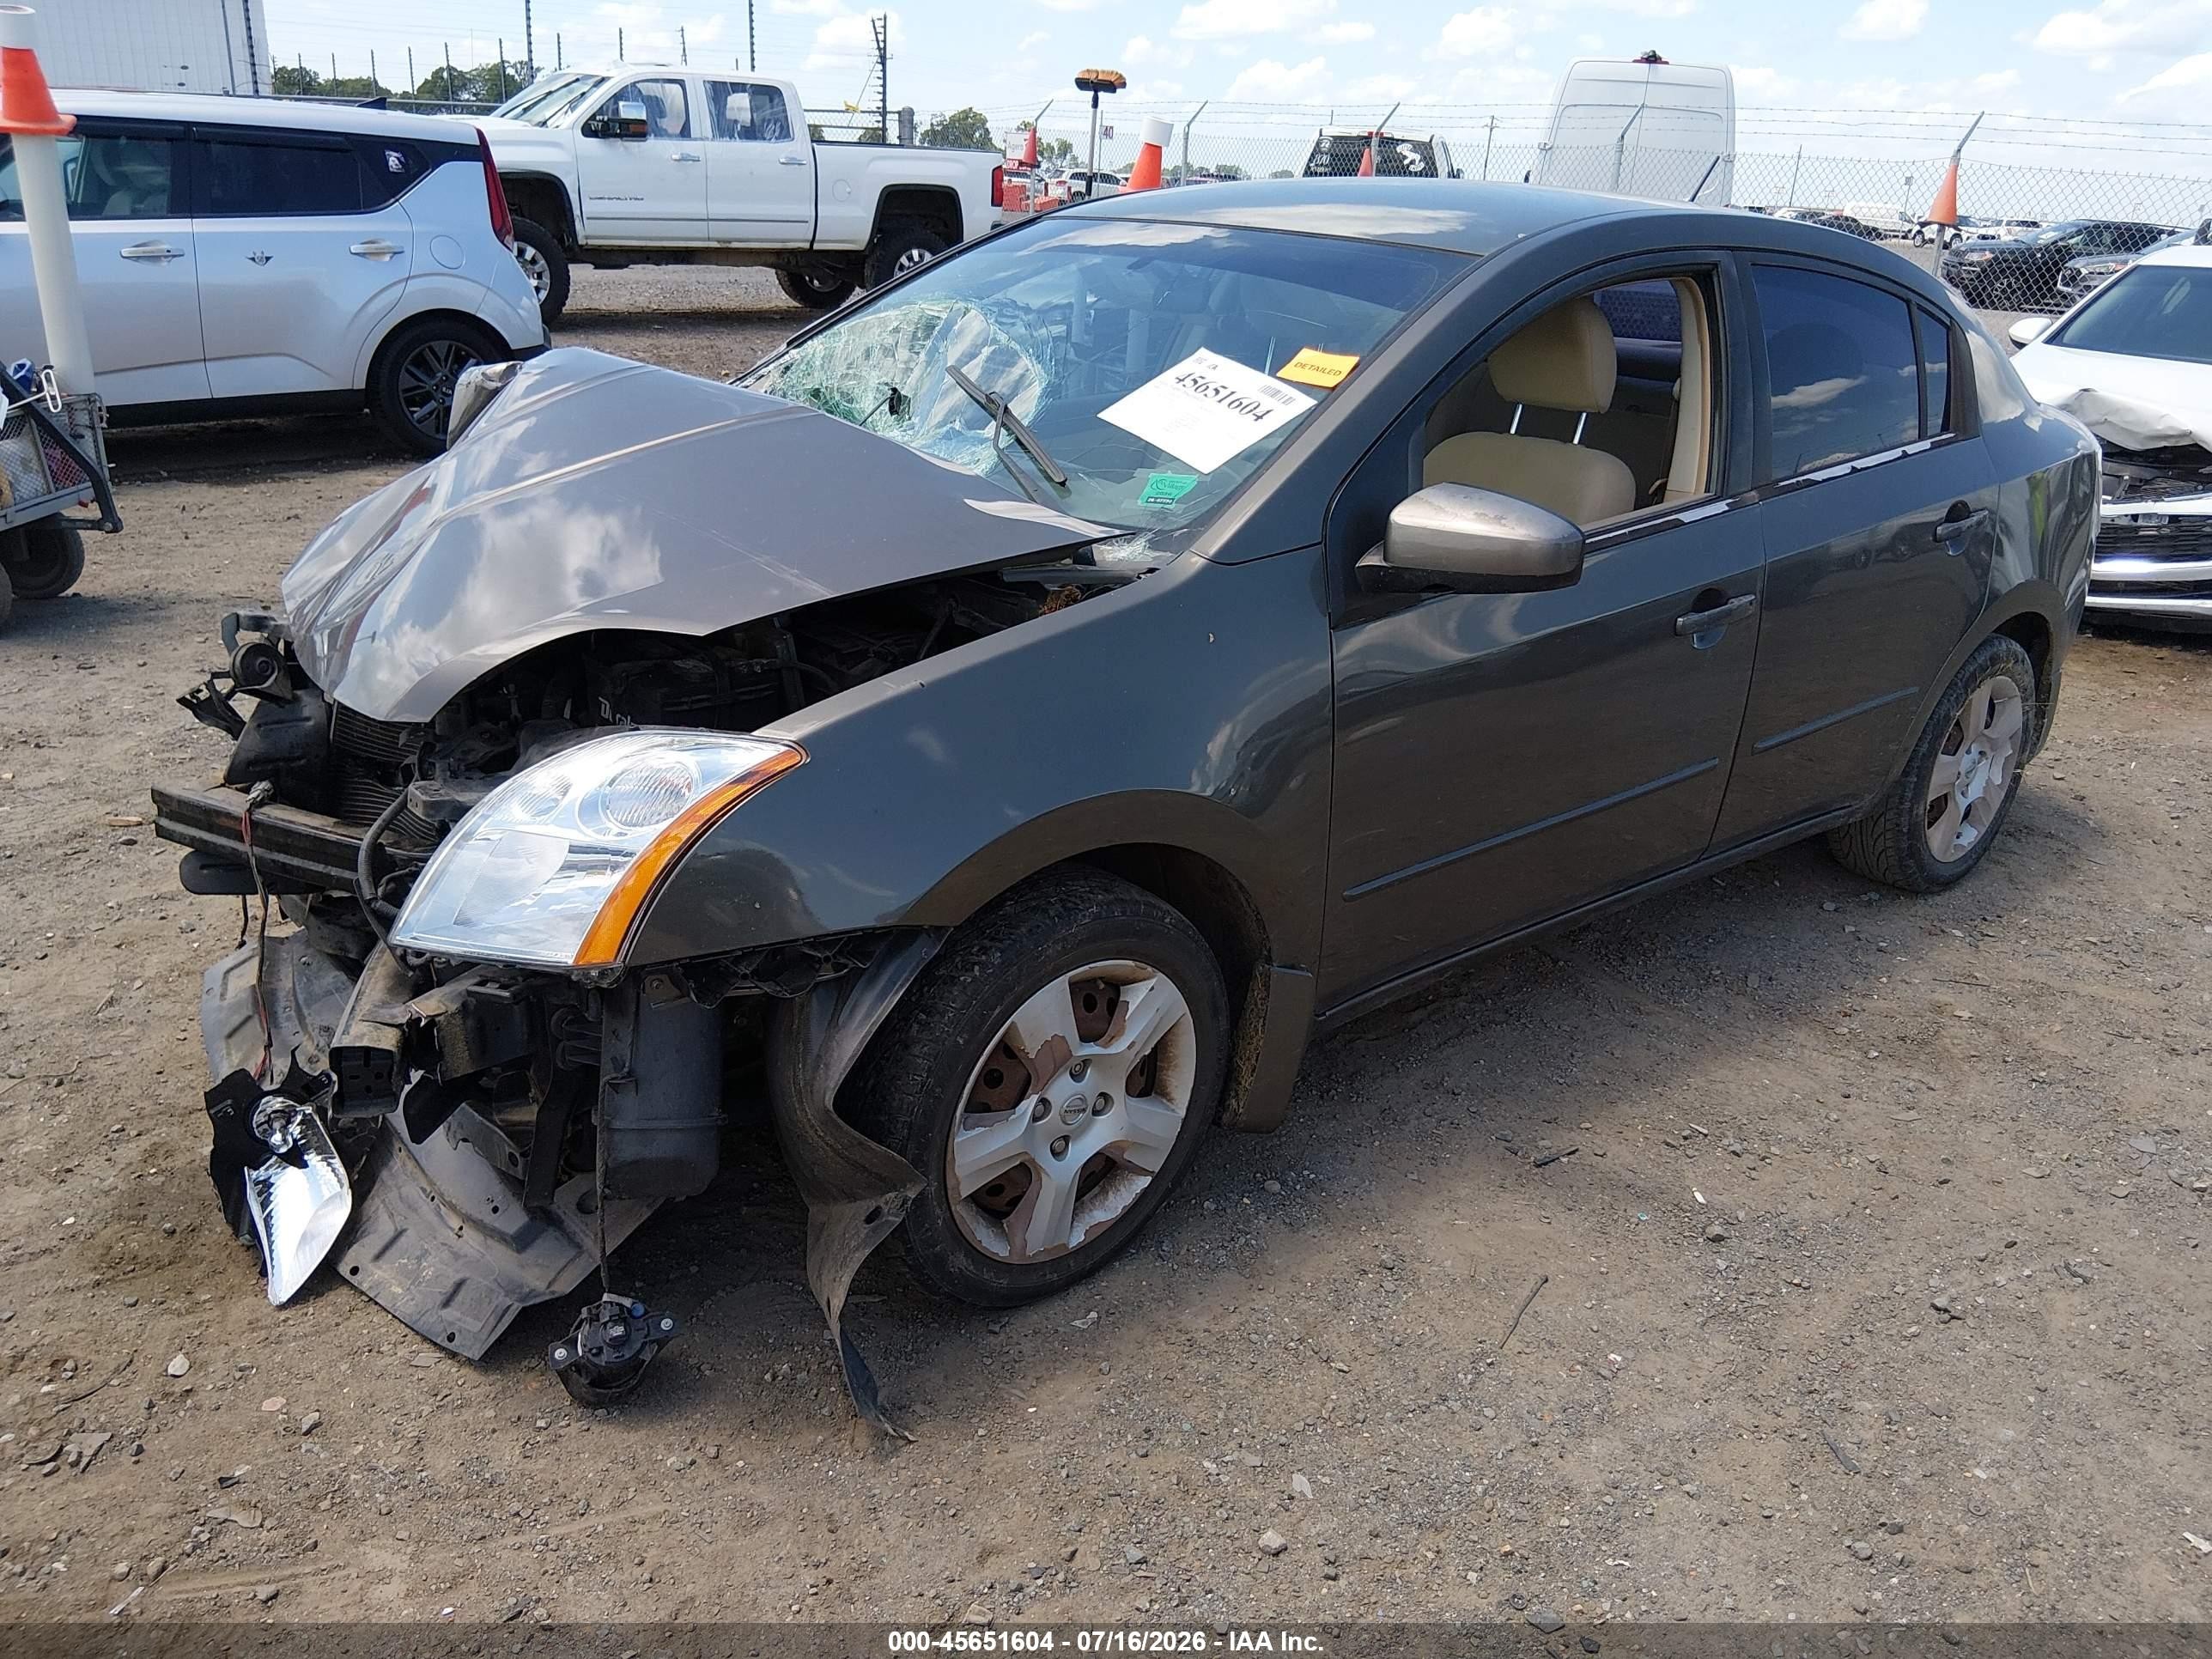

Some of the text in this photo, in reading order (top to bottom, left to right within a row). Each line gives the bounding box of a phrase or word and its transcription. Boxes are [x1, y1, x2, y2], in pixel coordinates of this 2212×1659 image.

[1103, 125, 1114, 139] 40
[1294, 362, 1342, 376] DETAILED
[1175, 372, 1274, 422] 45651604
